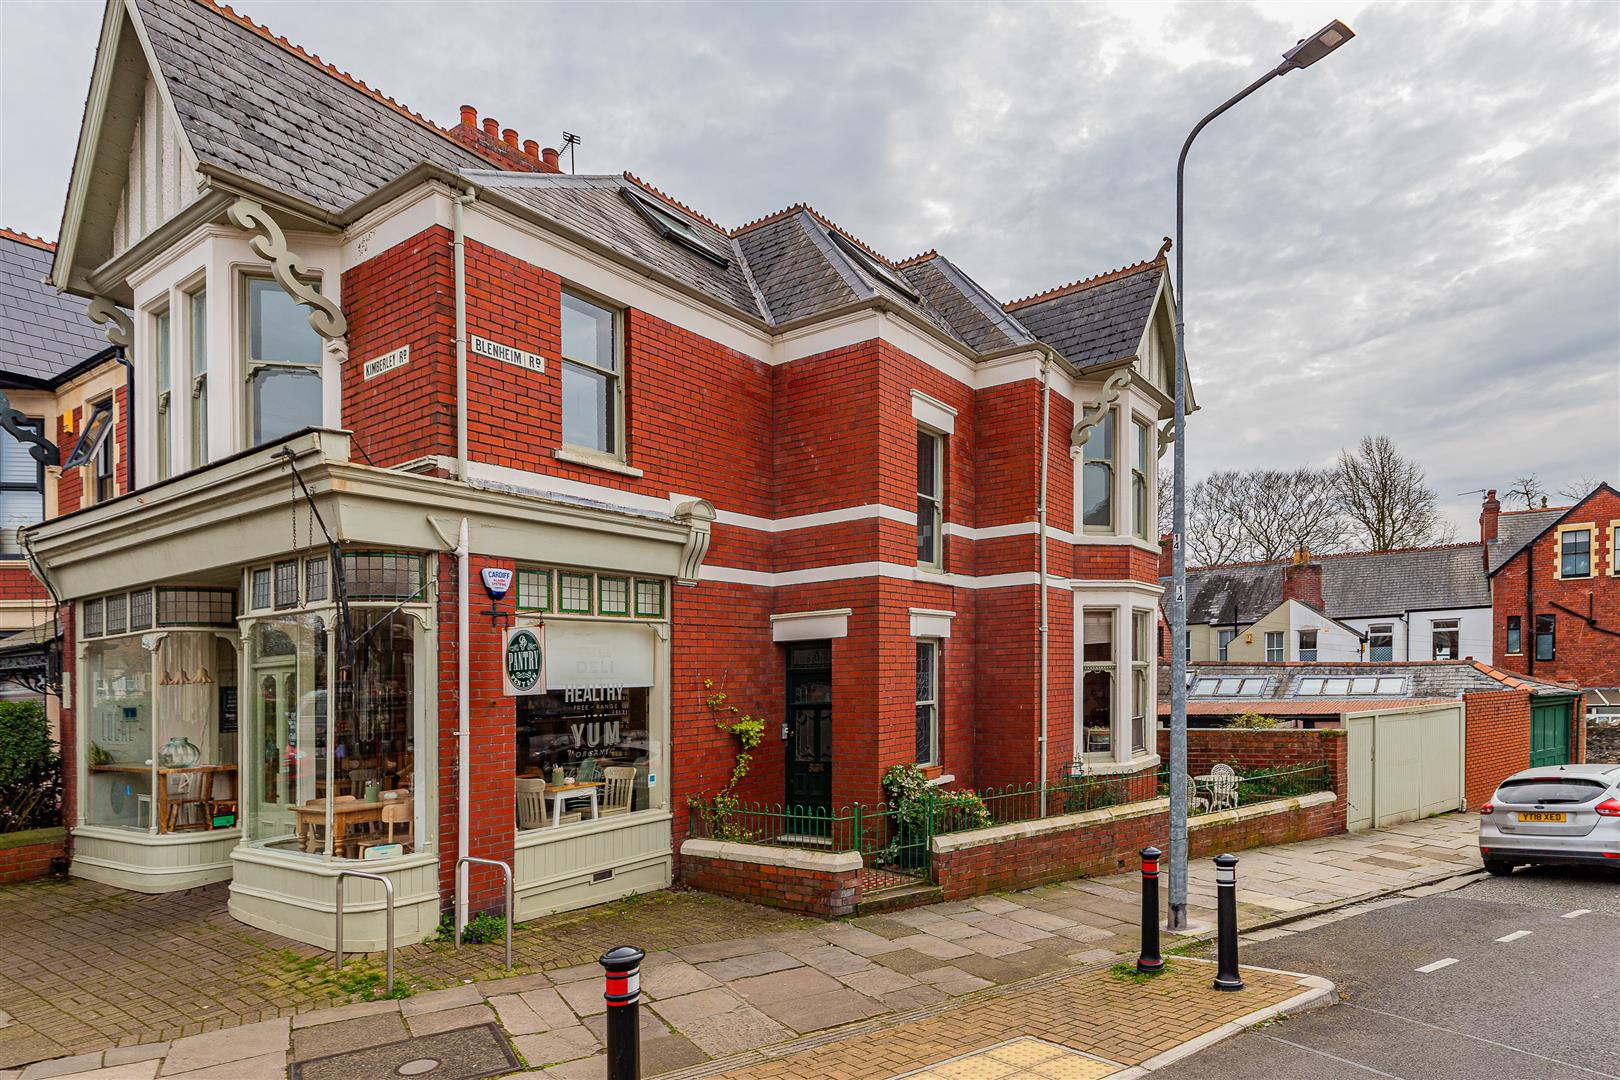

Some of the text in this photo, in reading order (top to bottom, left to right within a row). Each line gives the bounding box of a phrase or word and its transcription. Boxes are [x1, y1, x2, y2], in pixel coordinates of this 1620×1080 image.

[475, 338, 522, 365] BLENHEIM
[365, 353, 395, 377] KIMBERLEY
[488, 571, 510, 579] CARDIFF
[508, 650, 538, 671] PANTRY
[576, 660, 614, 674] DELI
[564, 682, 624, 702] HEALTHY
[571, 721, 620, 749] YUM
